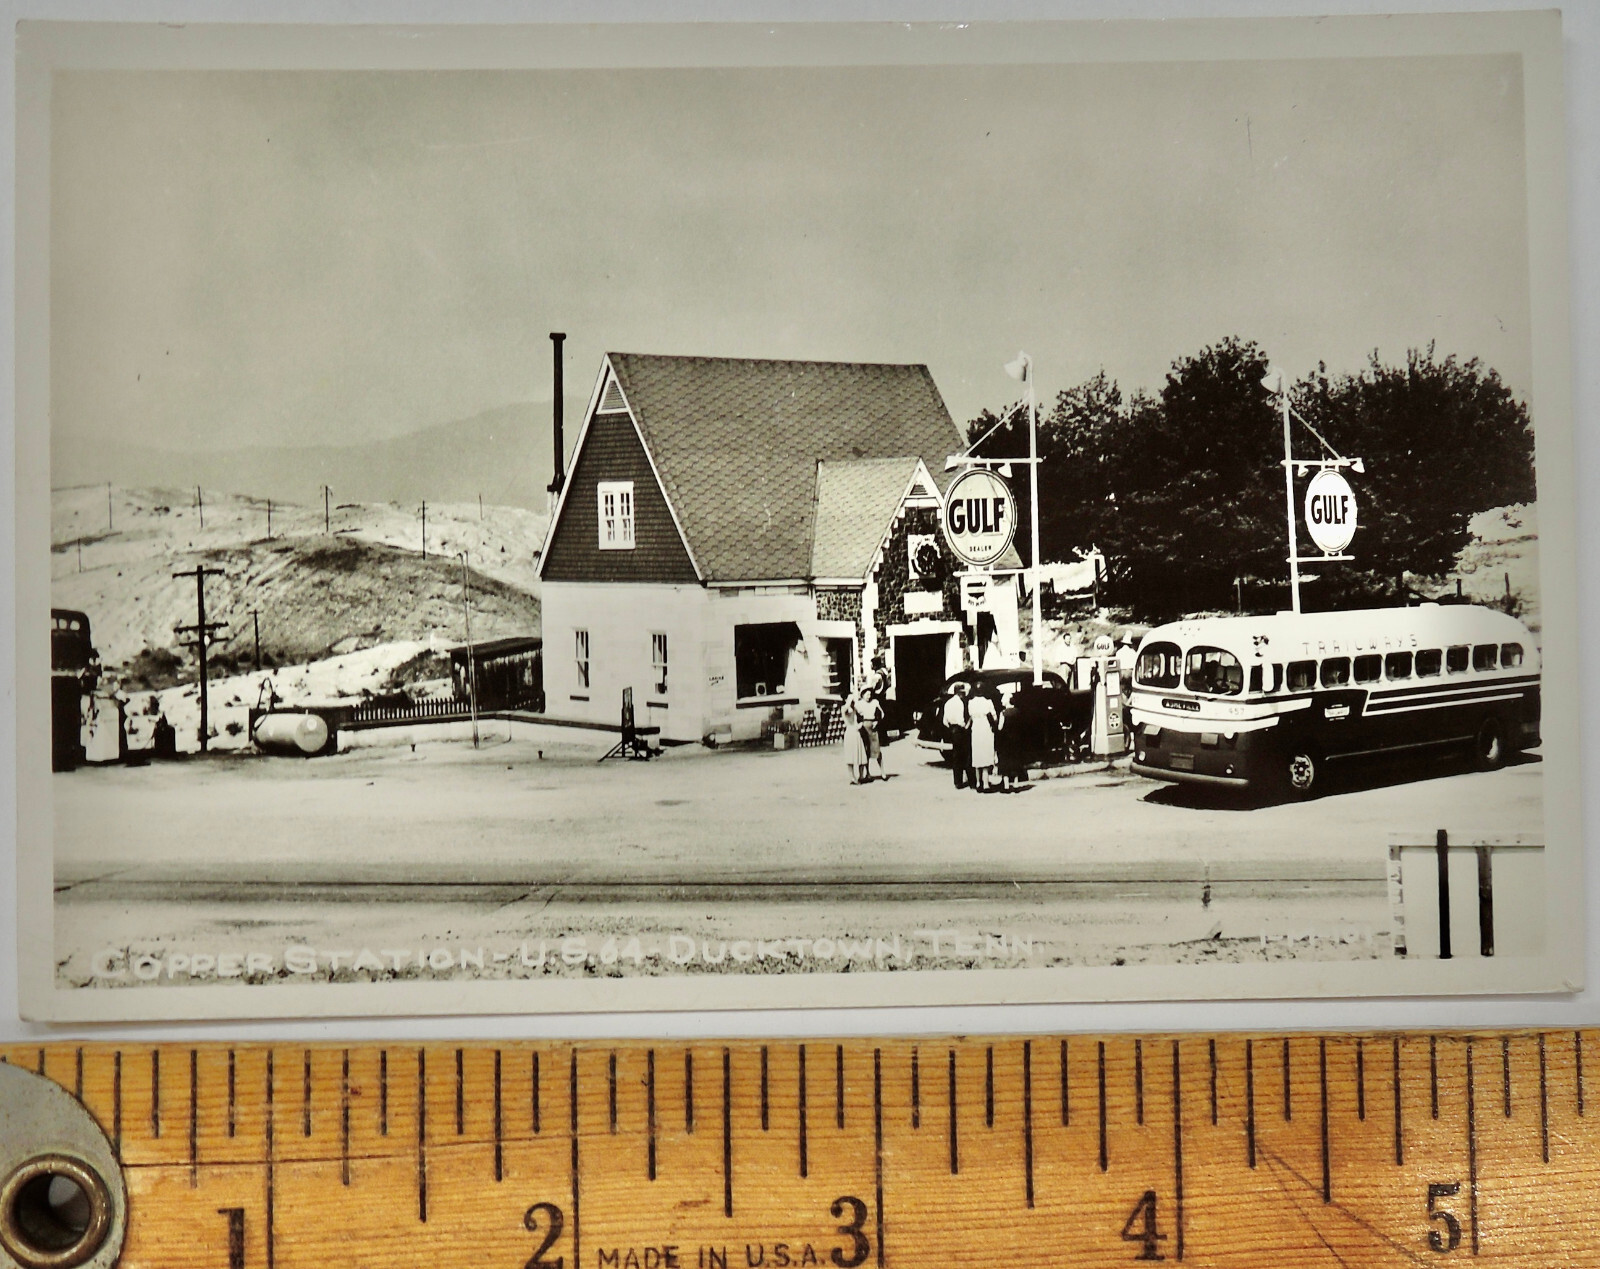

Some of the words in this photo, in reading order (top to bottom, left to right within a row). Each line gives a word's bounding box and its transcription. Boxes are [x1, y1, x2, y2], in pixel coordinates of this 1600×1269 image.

[949, 498, 1005, 536] GULF
[1311, 494, 1348, 524] GULF
[1302, 634, 1418, 655] TRAILWAYS
[218, 1207, 245, 1269] 1
[524, 1202, 564, 1269] 2
[831, 1196, 870, 1268] 3
[1122, 1190, 1168, 1261] 4
[1428, 1183, 1461, 1252] 5
[598, 1245, 681, 1269] MADE
[699, 1246, 727, 1269] IN
[746, 1243, 826, 1268] U.S.A.
